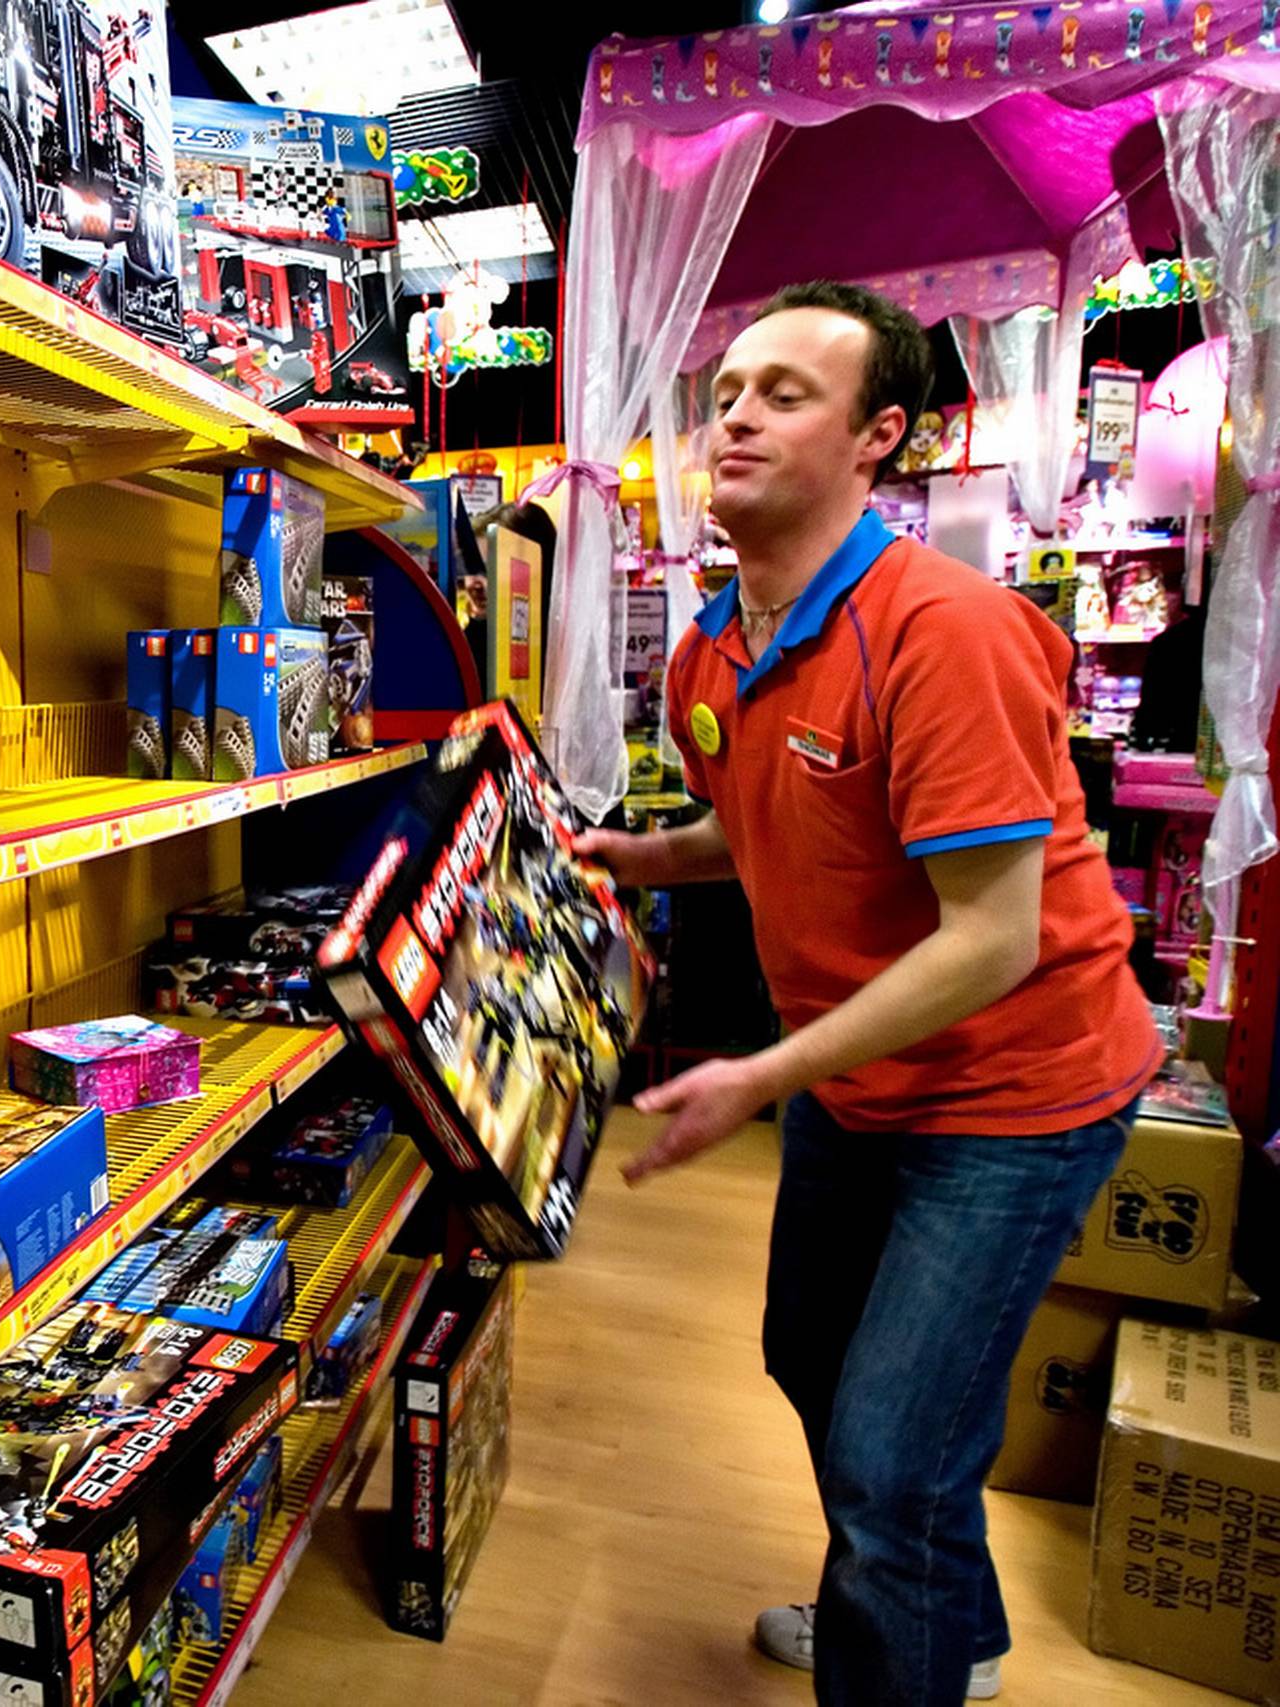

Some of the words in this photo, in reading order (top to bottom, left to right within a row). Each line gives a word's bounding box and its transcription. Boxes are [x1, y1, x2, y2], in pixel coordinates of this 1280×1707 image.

[303, 399, 348, 411] Ferrari
[160, 1325, 204, 1357] 8-14
[212, 1338, 257, 1369] LEGO
[1160, 1471, 1193, 1526] MADE
[1157, 1529, 1187, 1552] IN
[1186, 1538, 1218, 1561] 10
[1215, 1485, 1256, 1610] COPENHAGEN
[1122, 1561, 1153, 1599] KGS
[1151, 1556, 1185, 1611] CHINA
[1183, 1575, 1214, 1615] SET
[1243, 1591, 1278, 1664] 146520
